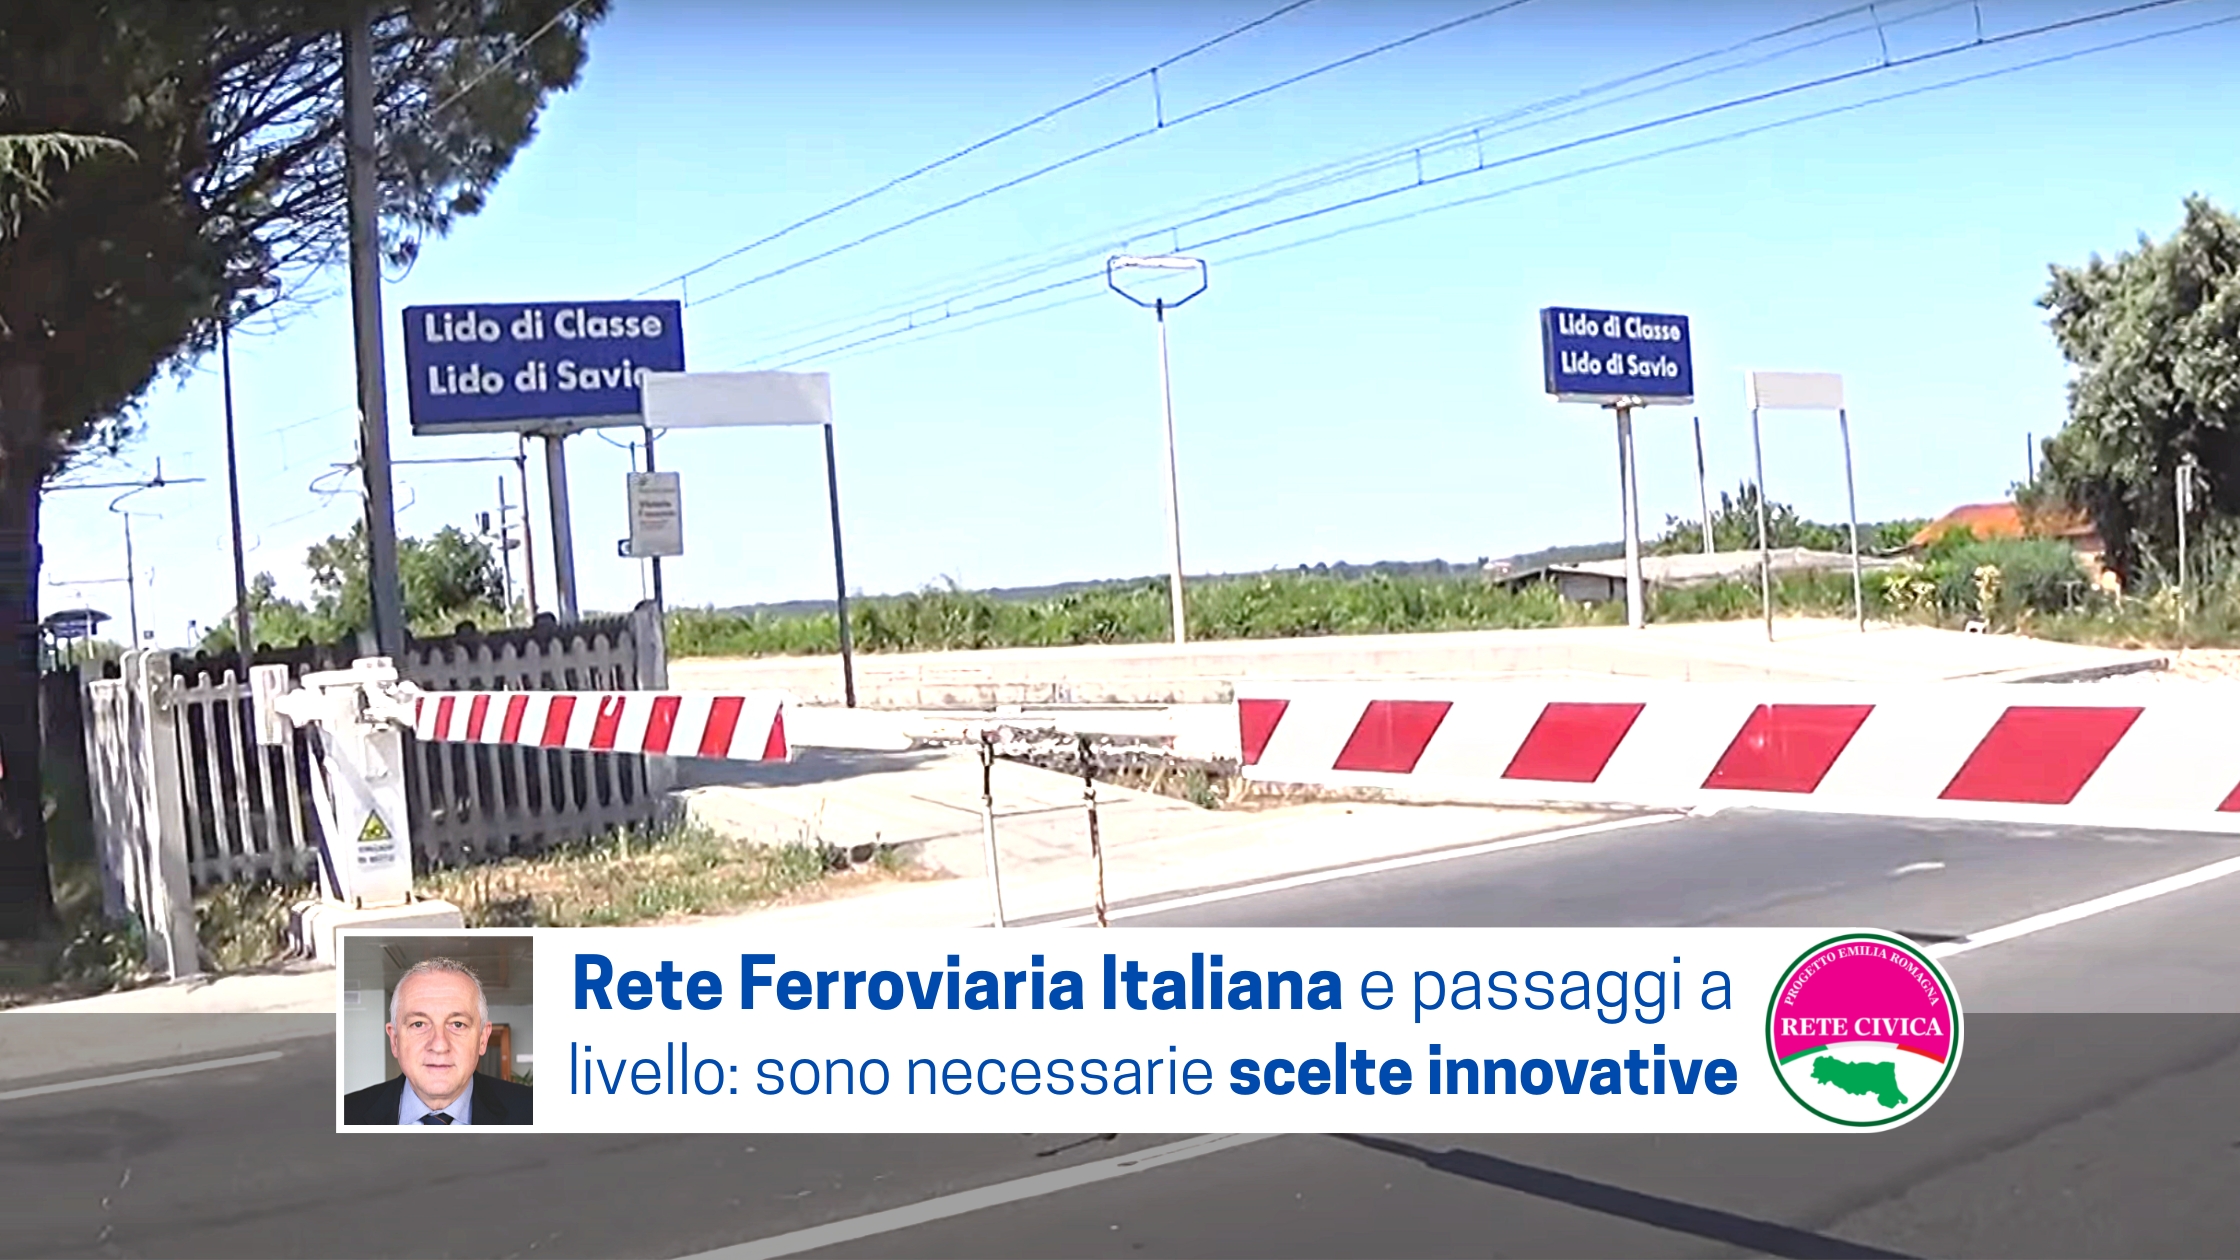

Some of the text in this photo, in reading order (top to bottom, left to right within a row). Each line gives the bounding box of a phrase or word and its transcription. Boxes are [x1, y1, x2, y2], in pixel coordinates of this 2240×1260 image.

[424, 306, 662, 342] Lido di Classe
[1558, 312, 1599, 337] Lido
[1603, 314, 1621, 338] di
[428, 363, 504, 395] Lido
[514, 361, 548, 392] di
[1561, 351, 1602, 375] Lido
[1606, 353, 1624, 375] di
